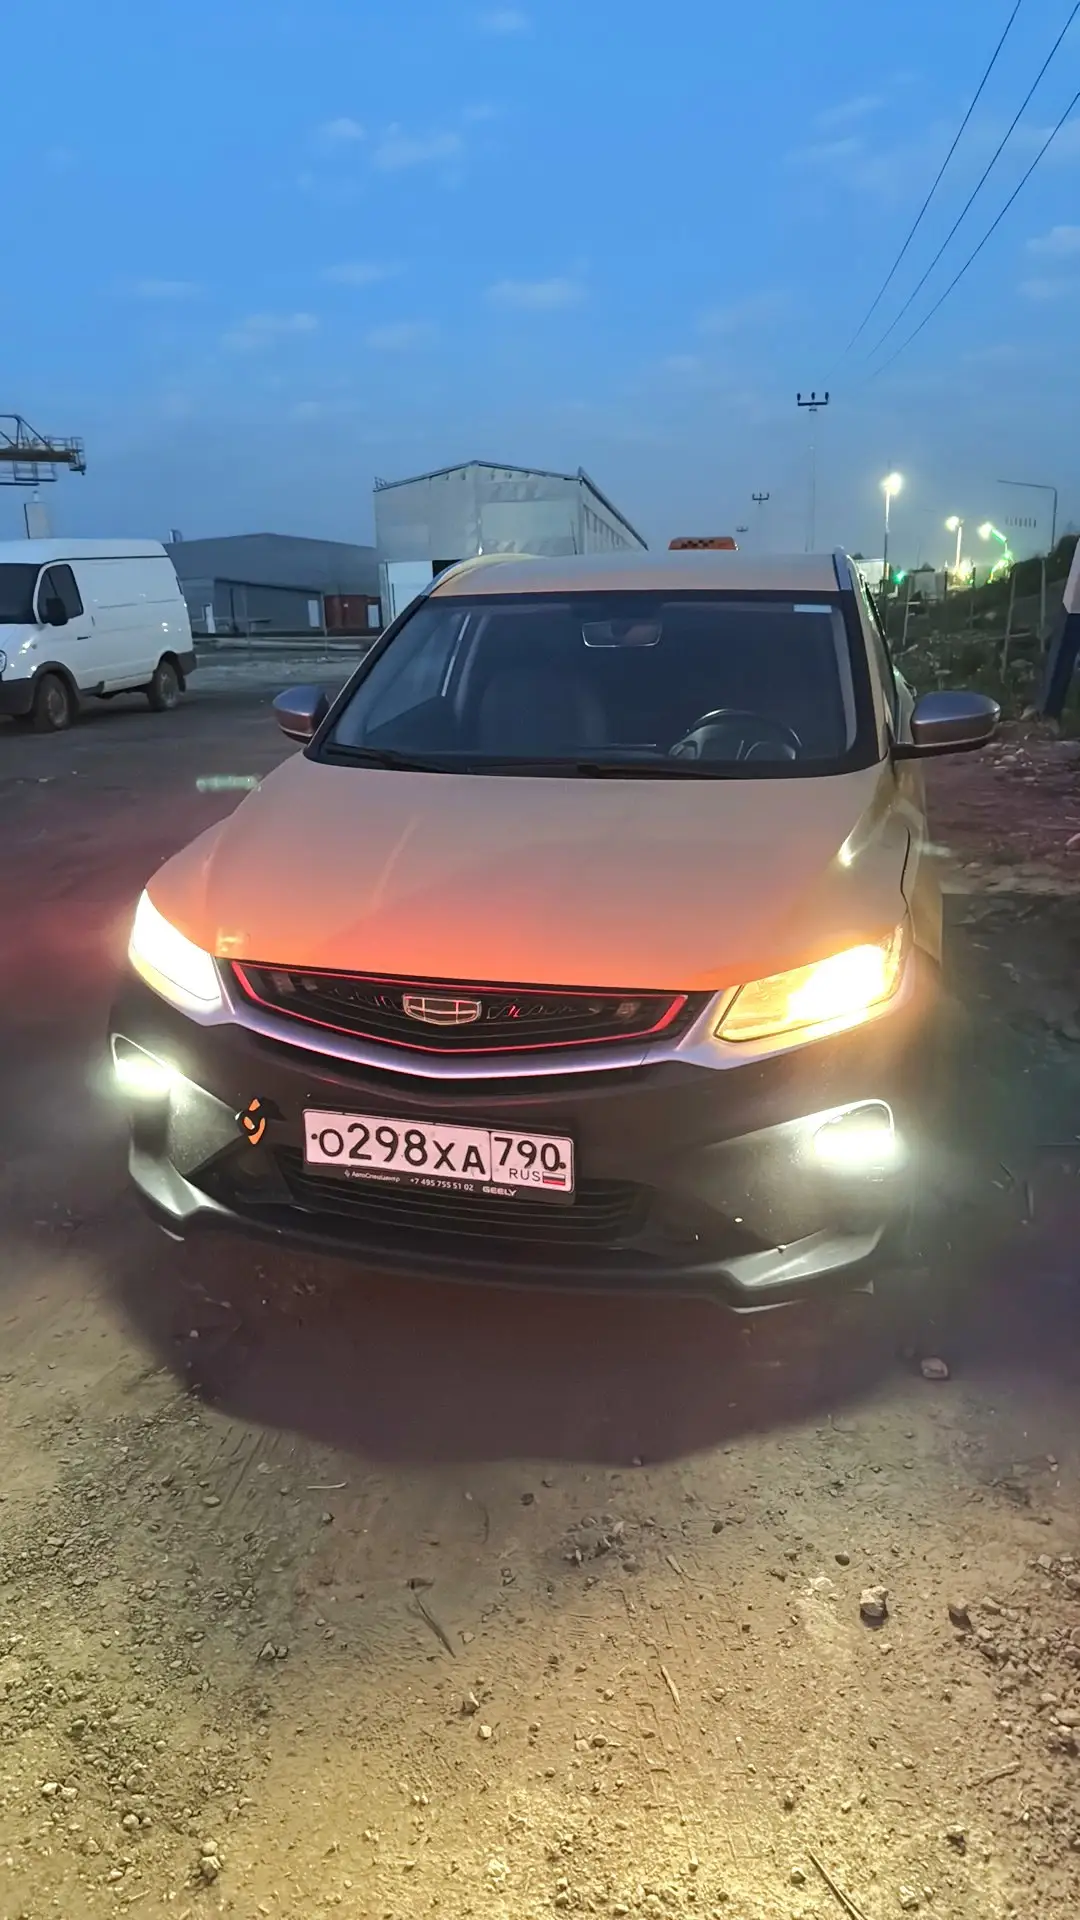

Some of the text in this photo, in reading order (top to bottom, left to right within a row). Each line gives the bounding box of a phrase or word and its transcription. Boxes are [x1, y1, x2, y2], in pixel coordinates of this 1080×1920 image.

[494, 1136, 561, 1172] 790
[508, 1167, 541, 1182] RUS
[410, 1177, 474, 1192] +7 495 755 51 02
[482, 1185, 517, 1197] GEELY
